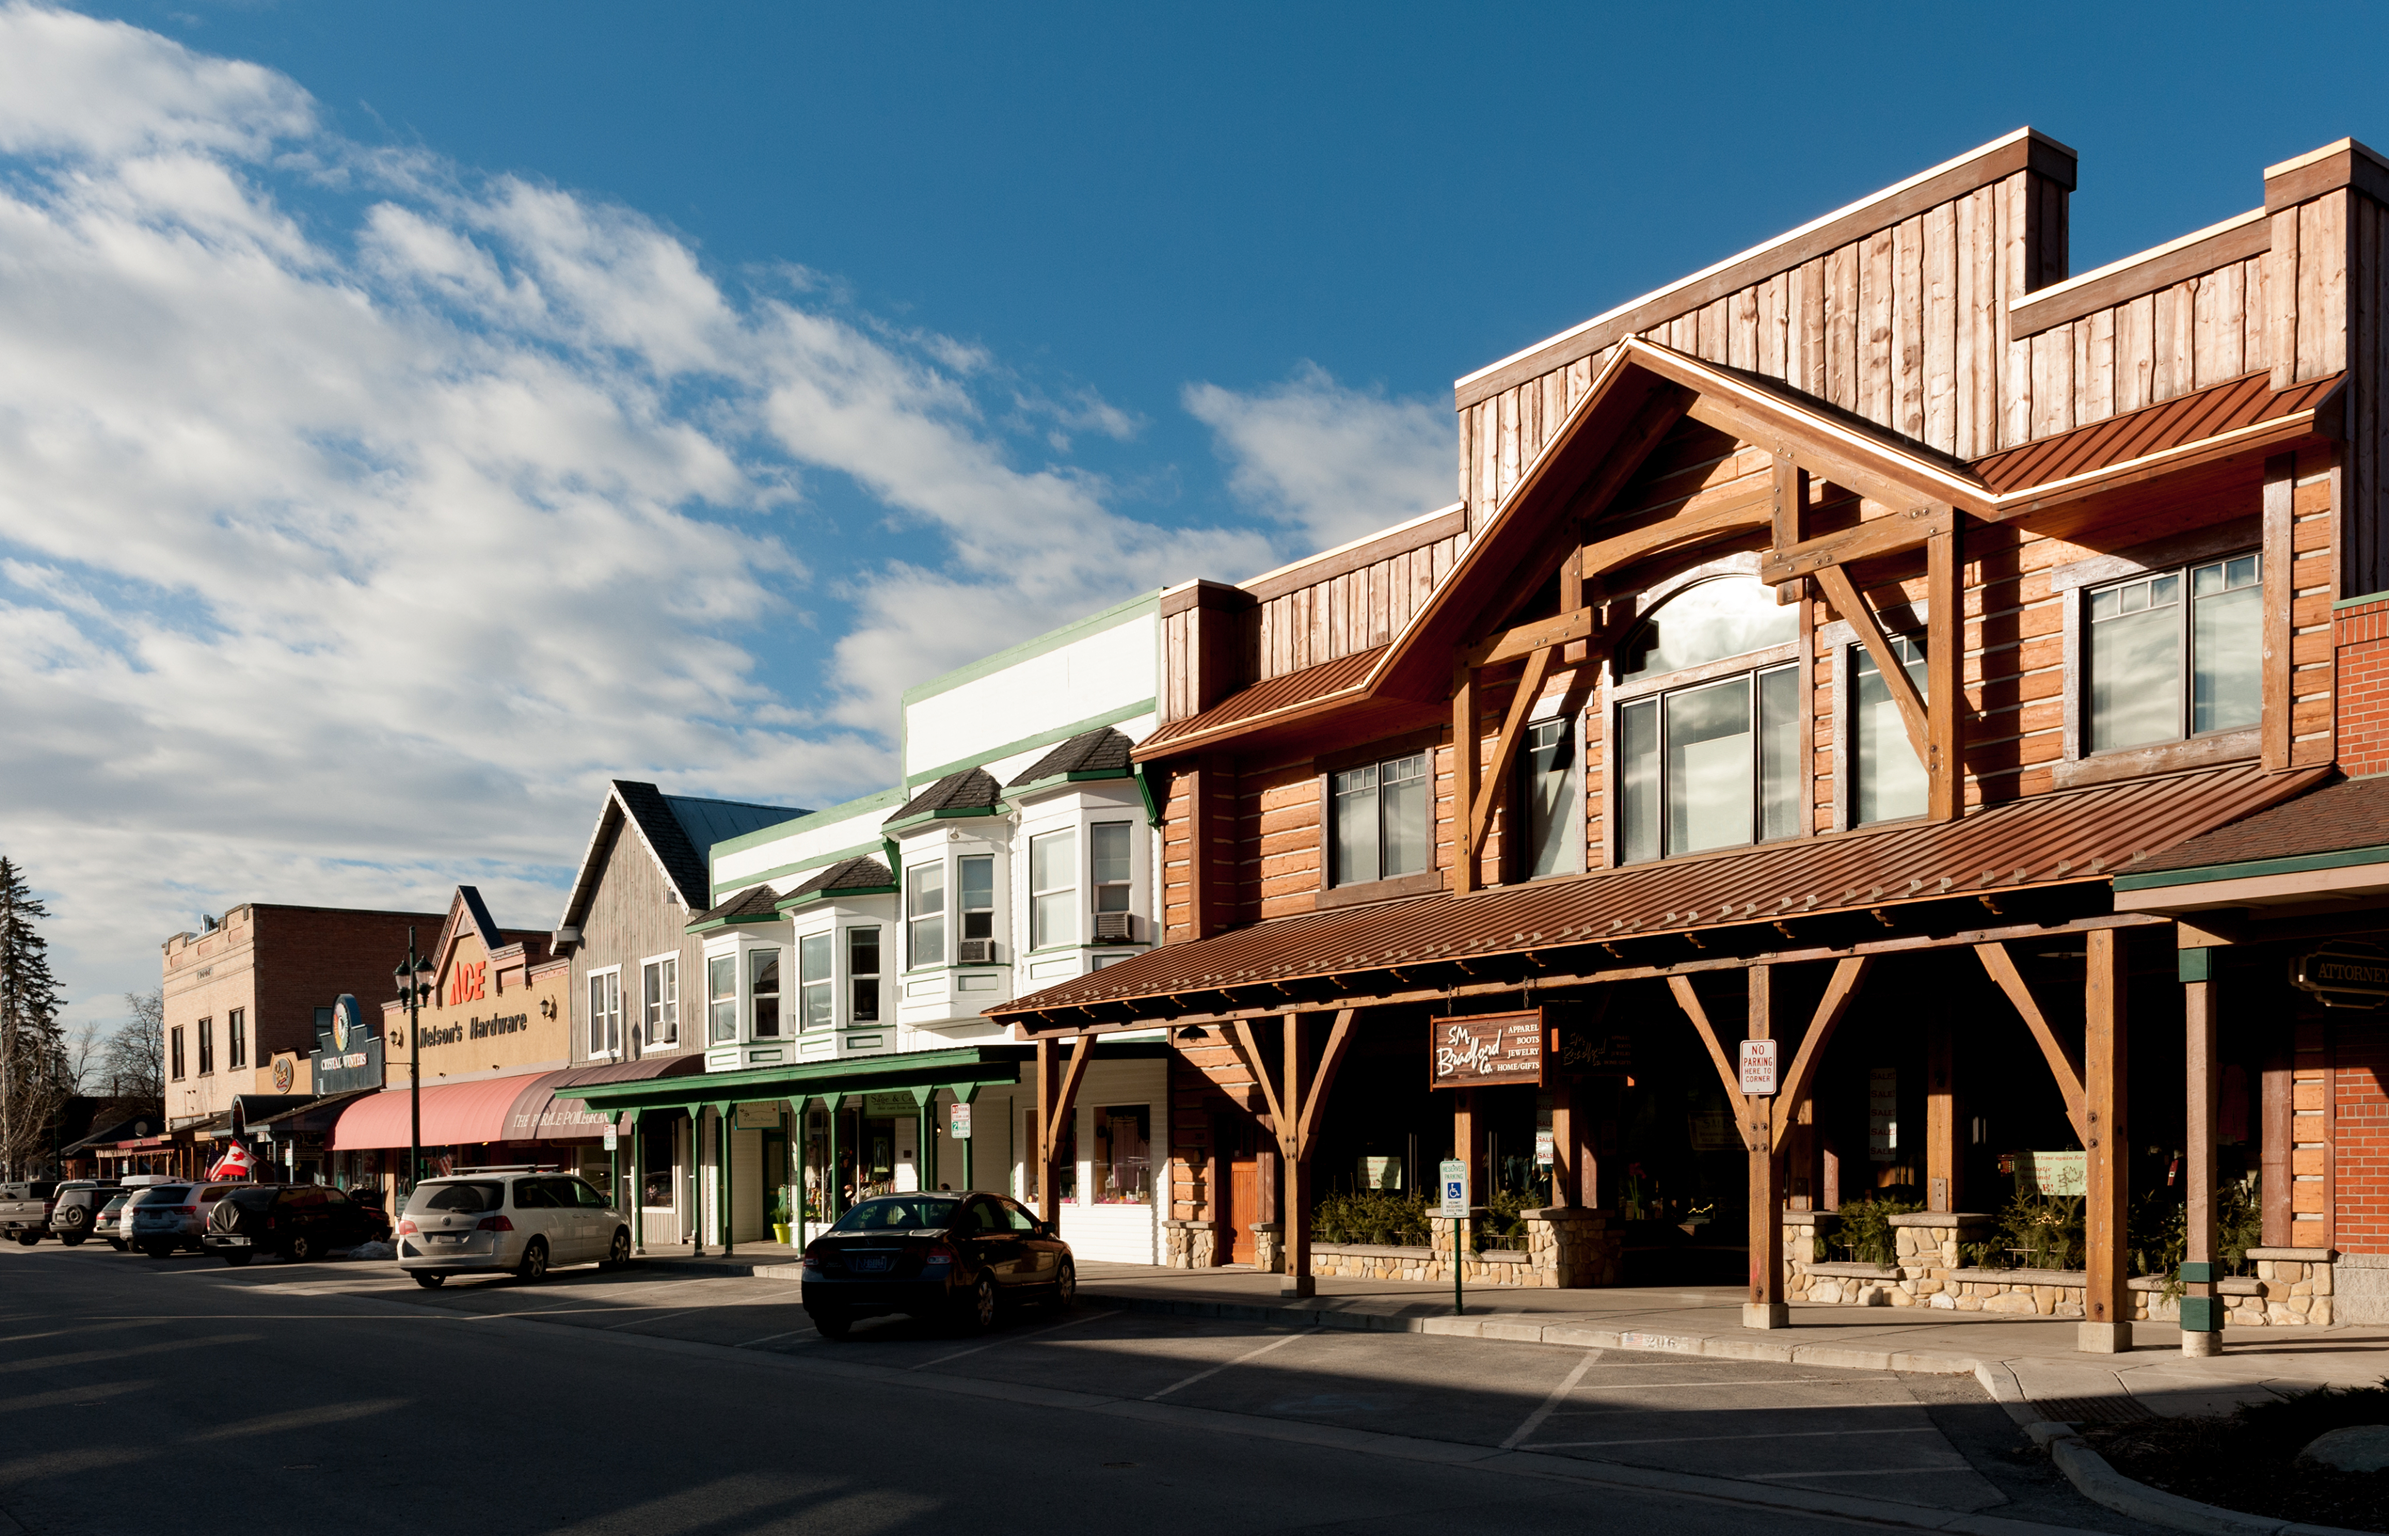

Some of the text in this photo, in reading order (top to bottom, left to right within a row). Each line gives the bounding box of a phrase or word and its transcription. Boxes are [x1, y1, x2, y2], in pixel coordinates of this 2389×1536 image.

[2317, 963, 2389, 984] ATTORNEY
[450, 960, 486, 1006] ACE
[419, 1013, 528, 1049] Nelson's Hardware
[1508, 1024, 1540, 1034] APPAREL
[1516, 1036, 1540, 1045] BOOTS
[1437, 1028, 1502, 1077] Bradford
[1507, 1048, 1540, 1059] JEWELRY
[1751, 1045, 1765, 1056] NO
[1479, 1055, 1493, 1075] Co.
[1497, 1062, 1540, 1072] HOME/GIFTS
[1743, 1057, 1773, 1067] PARKING
[1764, 1067, 1772, 1075] TO
[1745, 1075, 1771, 1083] CORNER
[892, 1094, 900, 1103] &
[513, 1114, 530, 1128] THE
